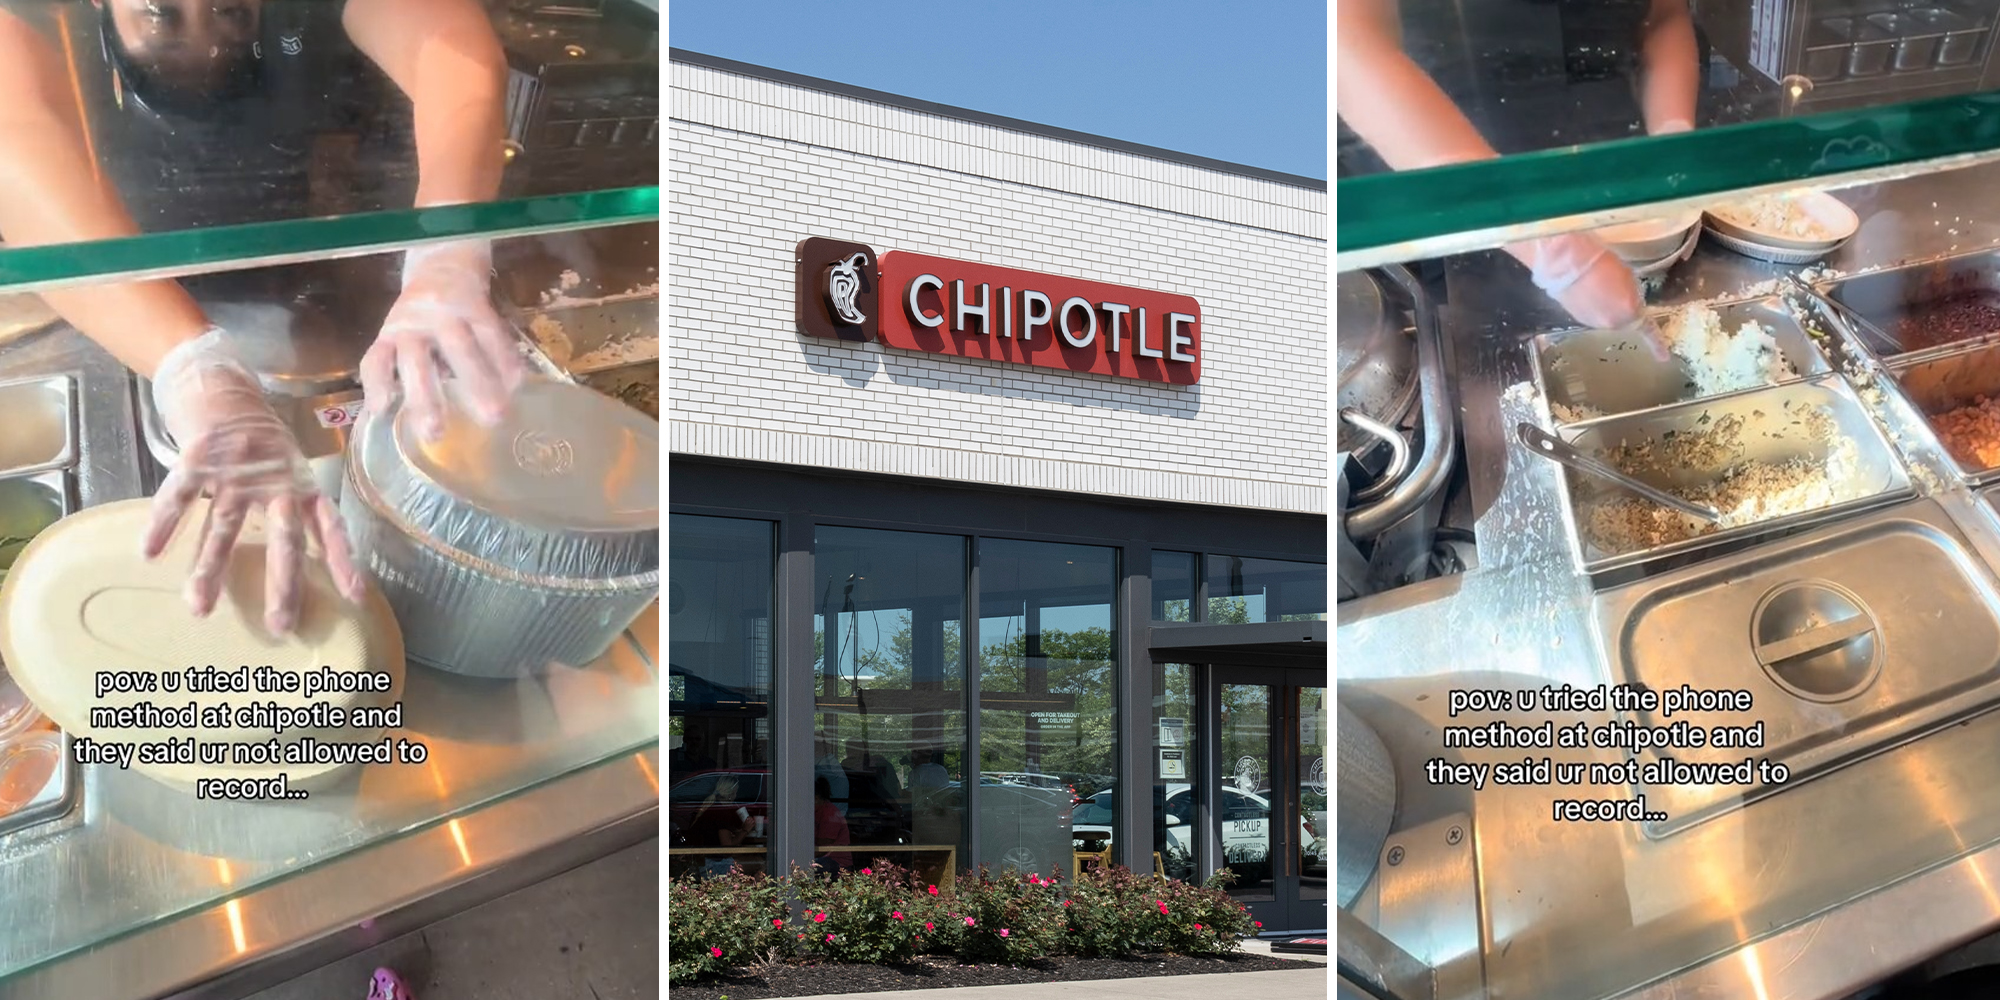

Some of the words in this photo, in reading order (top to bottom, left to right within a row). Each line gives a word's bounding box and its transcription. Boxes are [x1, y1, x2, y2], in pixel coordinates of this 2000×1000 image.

[907, 273, 1197, 363] CHIPOTLE
[1233, 820, 1261, 832] PICKUP
[1229, 850, 1266, 864] DELIVERY
